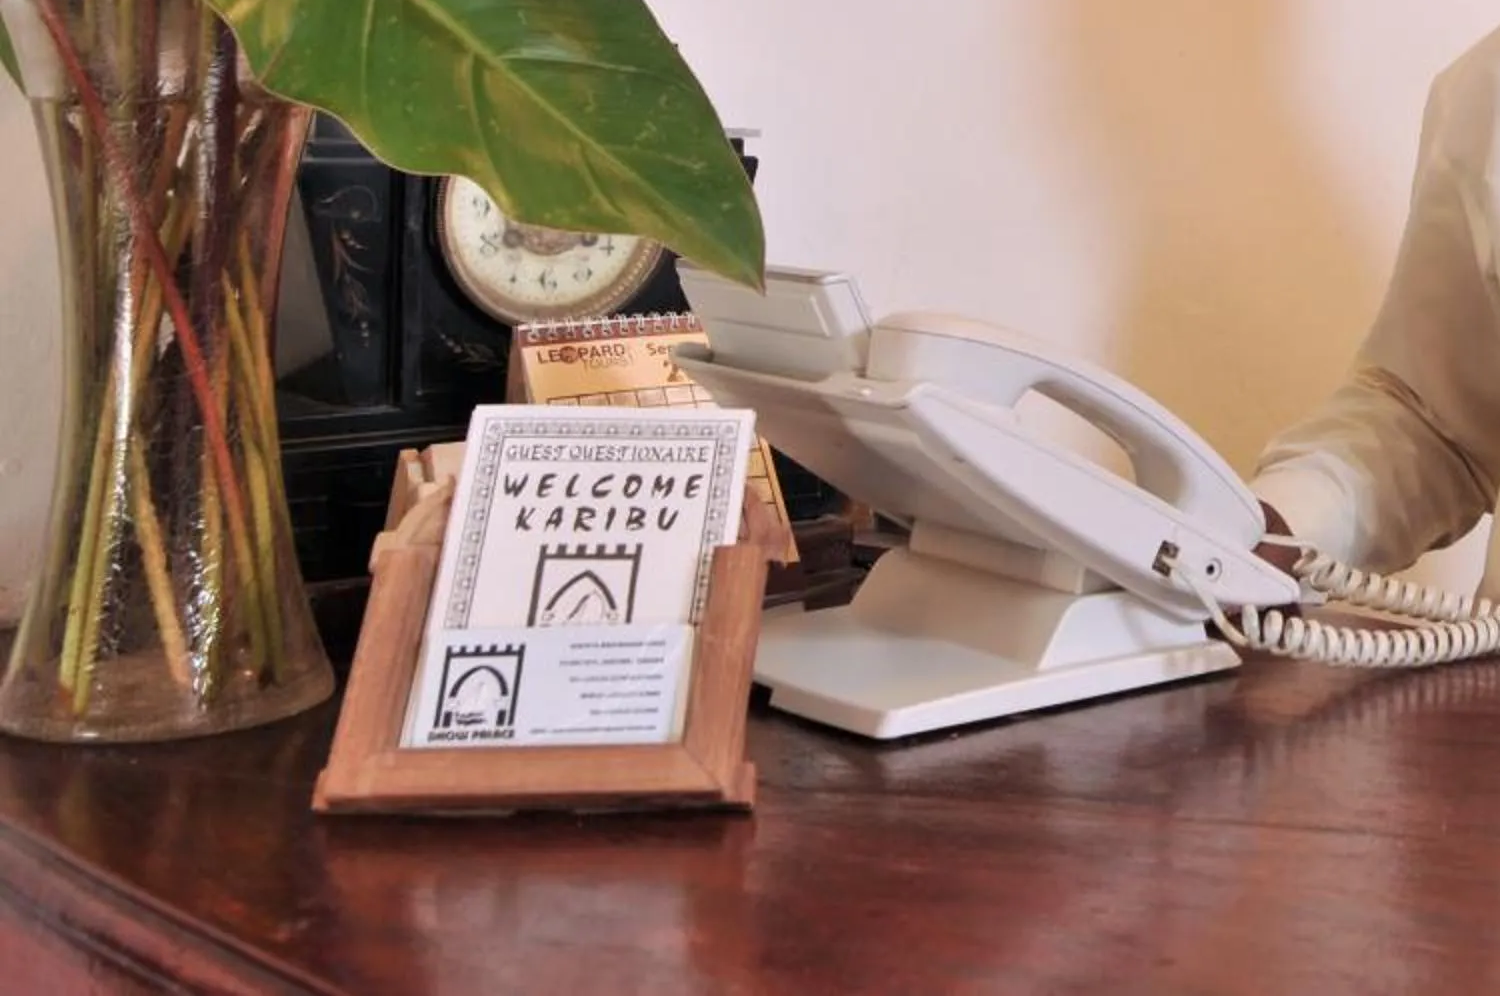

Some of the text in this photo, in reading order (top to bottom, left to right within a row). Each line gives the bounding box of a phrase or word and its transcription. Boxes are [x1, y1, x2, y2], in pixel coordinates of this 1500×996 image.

[537, 343, 626, 366] LEOPARD
[505, 444, 709, 464] GUEST QUESTIONAIRE
[503, 472, 704, 500] WELCOME
[515, 506, 679, 533] KARIBU
